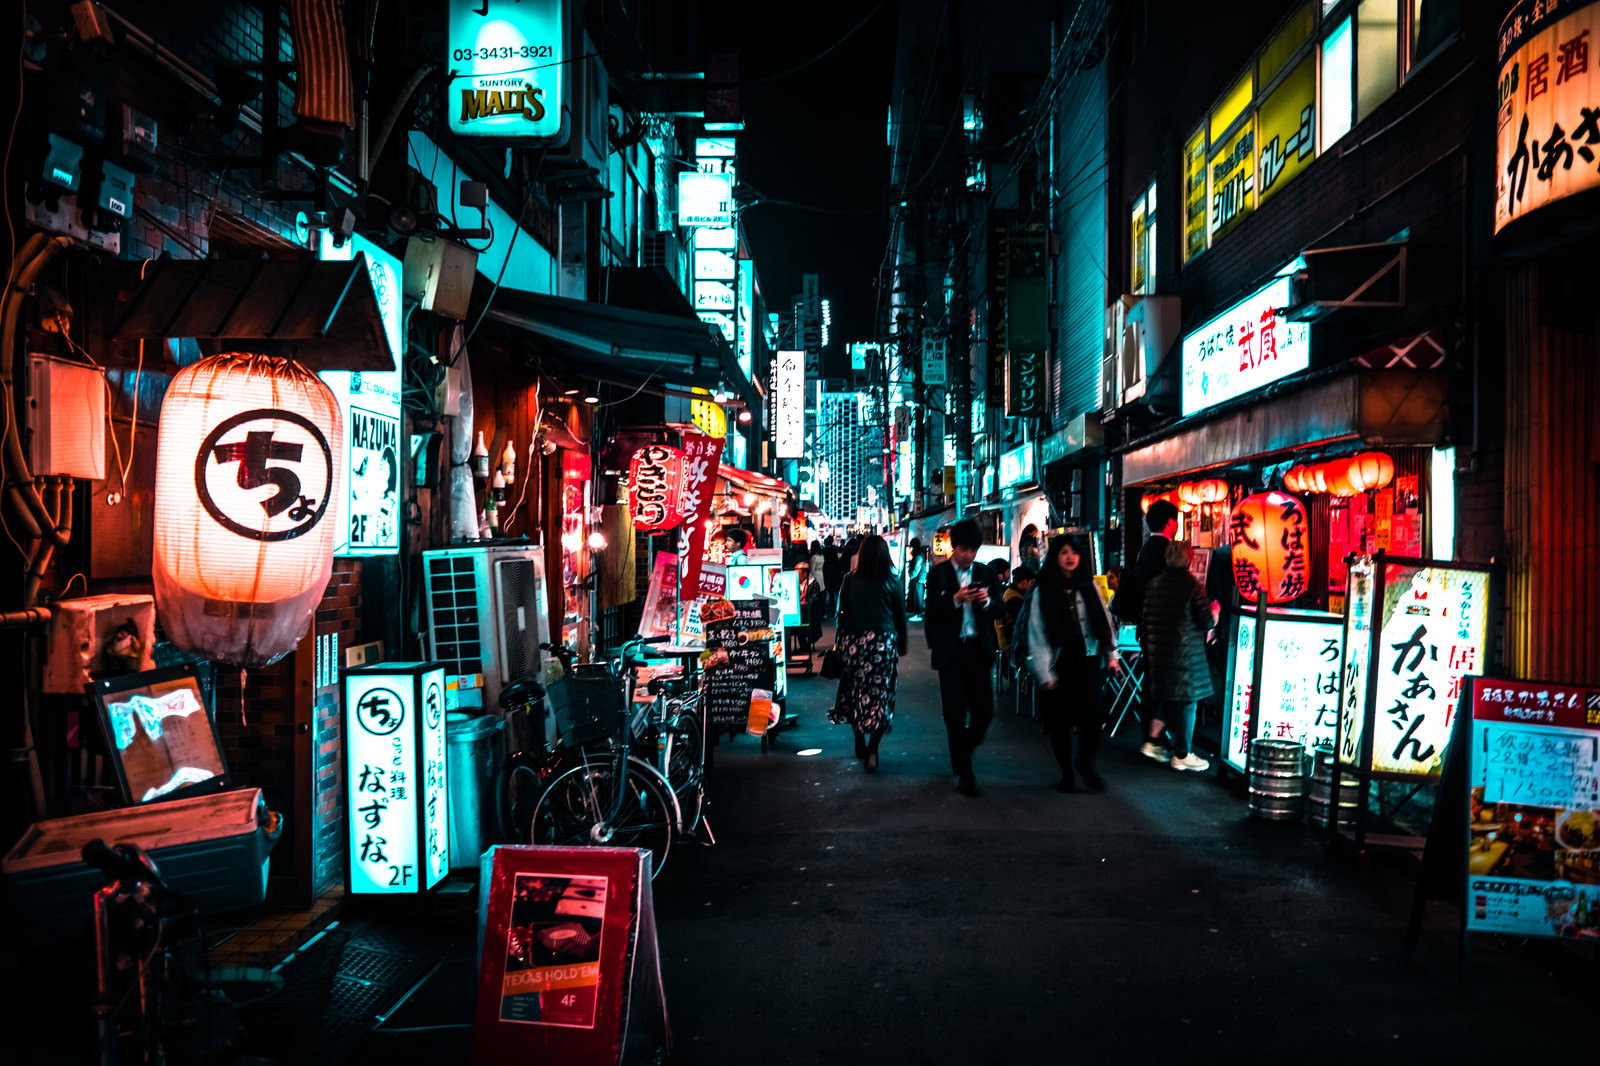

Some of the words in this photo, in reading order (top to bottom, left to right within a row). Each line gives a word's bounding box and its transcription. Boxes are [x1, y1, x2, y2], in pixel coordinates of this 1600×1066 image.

[453, 45, 553, 62] 03-3431-3921
[1526, 29, 1600, 104] 居酒
[479, 80, 524, 88] SUNTORY
[460, 83, 546, 122] MALT'S
[1507, 108, 1600, 216] かあさ
[351, 514, 368, 543] 2F
[357, 764, 399, 864] なずな
[388, 866, 413, 887] 2F
[504, 971, 543, 989] TEXAS
[545, 965, 599, 983] HOLD'EM
[561, 994, 576, 1007] 4F
